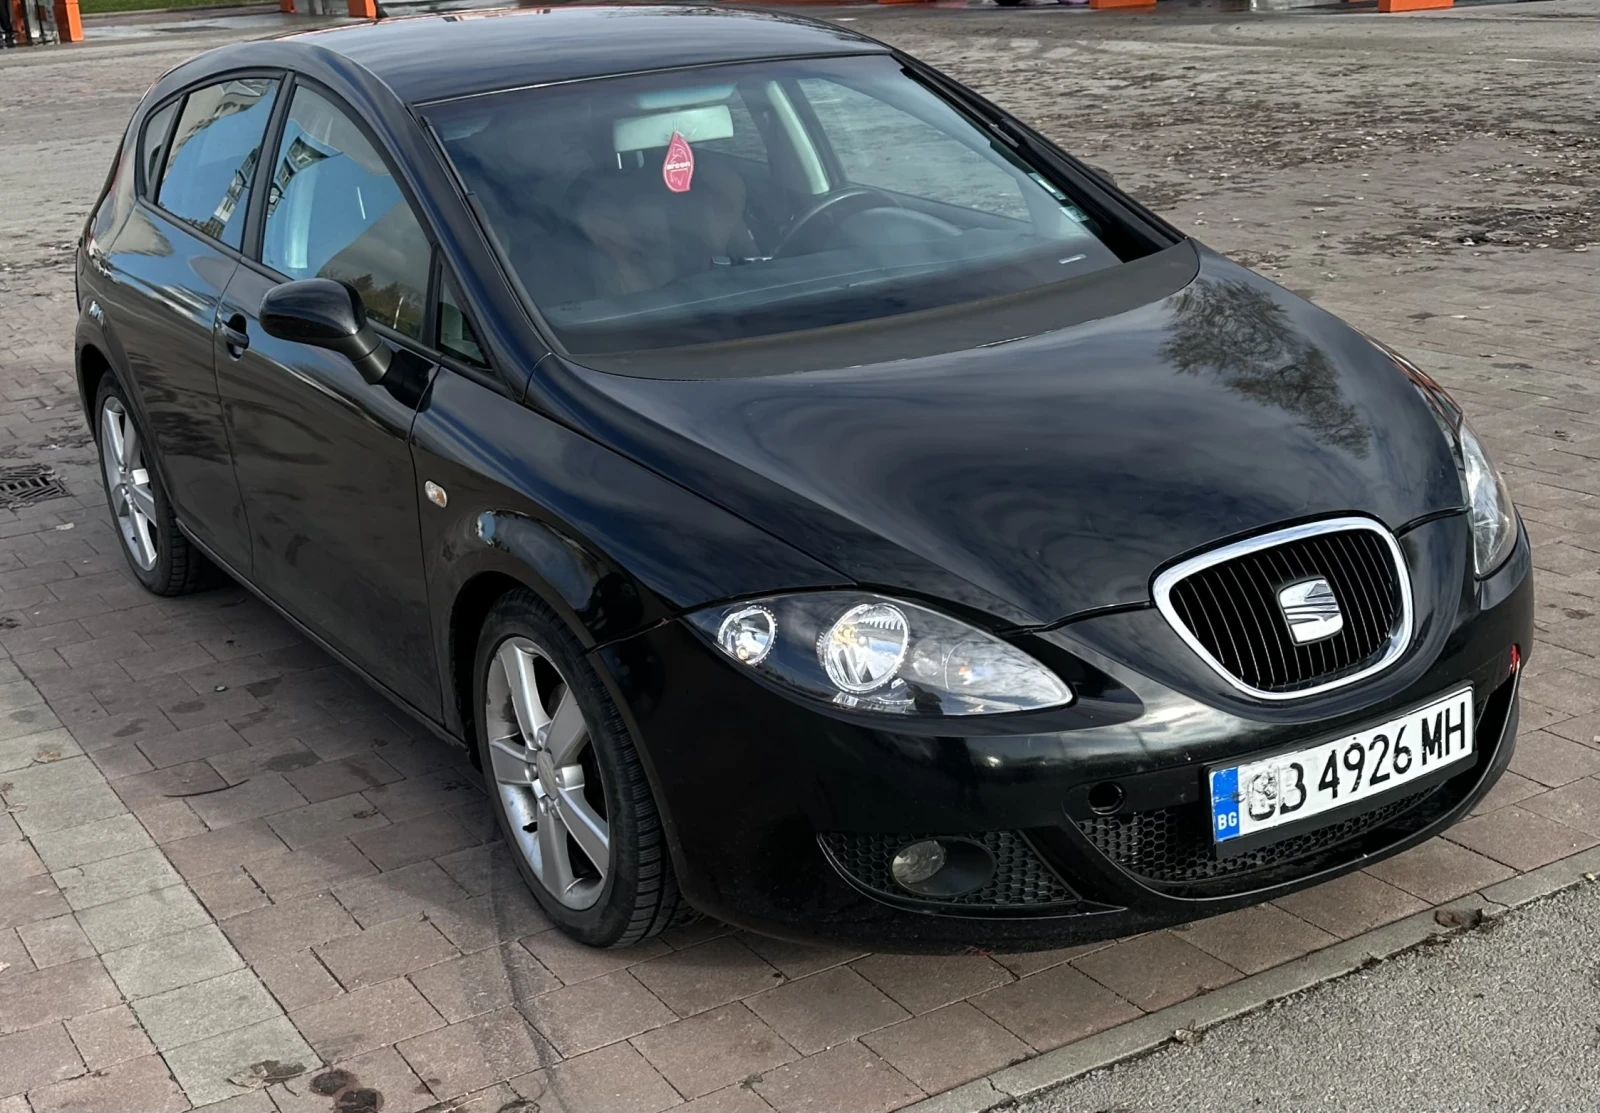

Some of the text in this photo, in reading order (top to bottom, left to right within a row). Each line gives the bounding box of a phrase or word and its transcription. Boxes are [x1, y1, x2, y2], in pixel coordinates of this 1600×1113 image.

[1318, 725, 1412, 799] 4926
[1421, 701, 1466, 766] MH
[1217, 812, 1237, 830] BG
